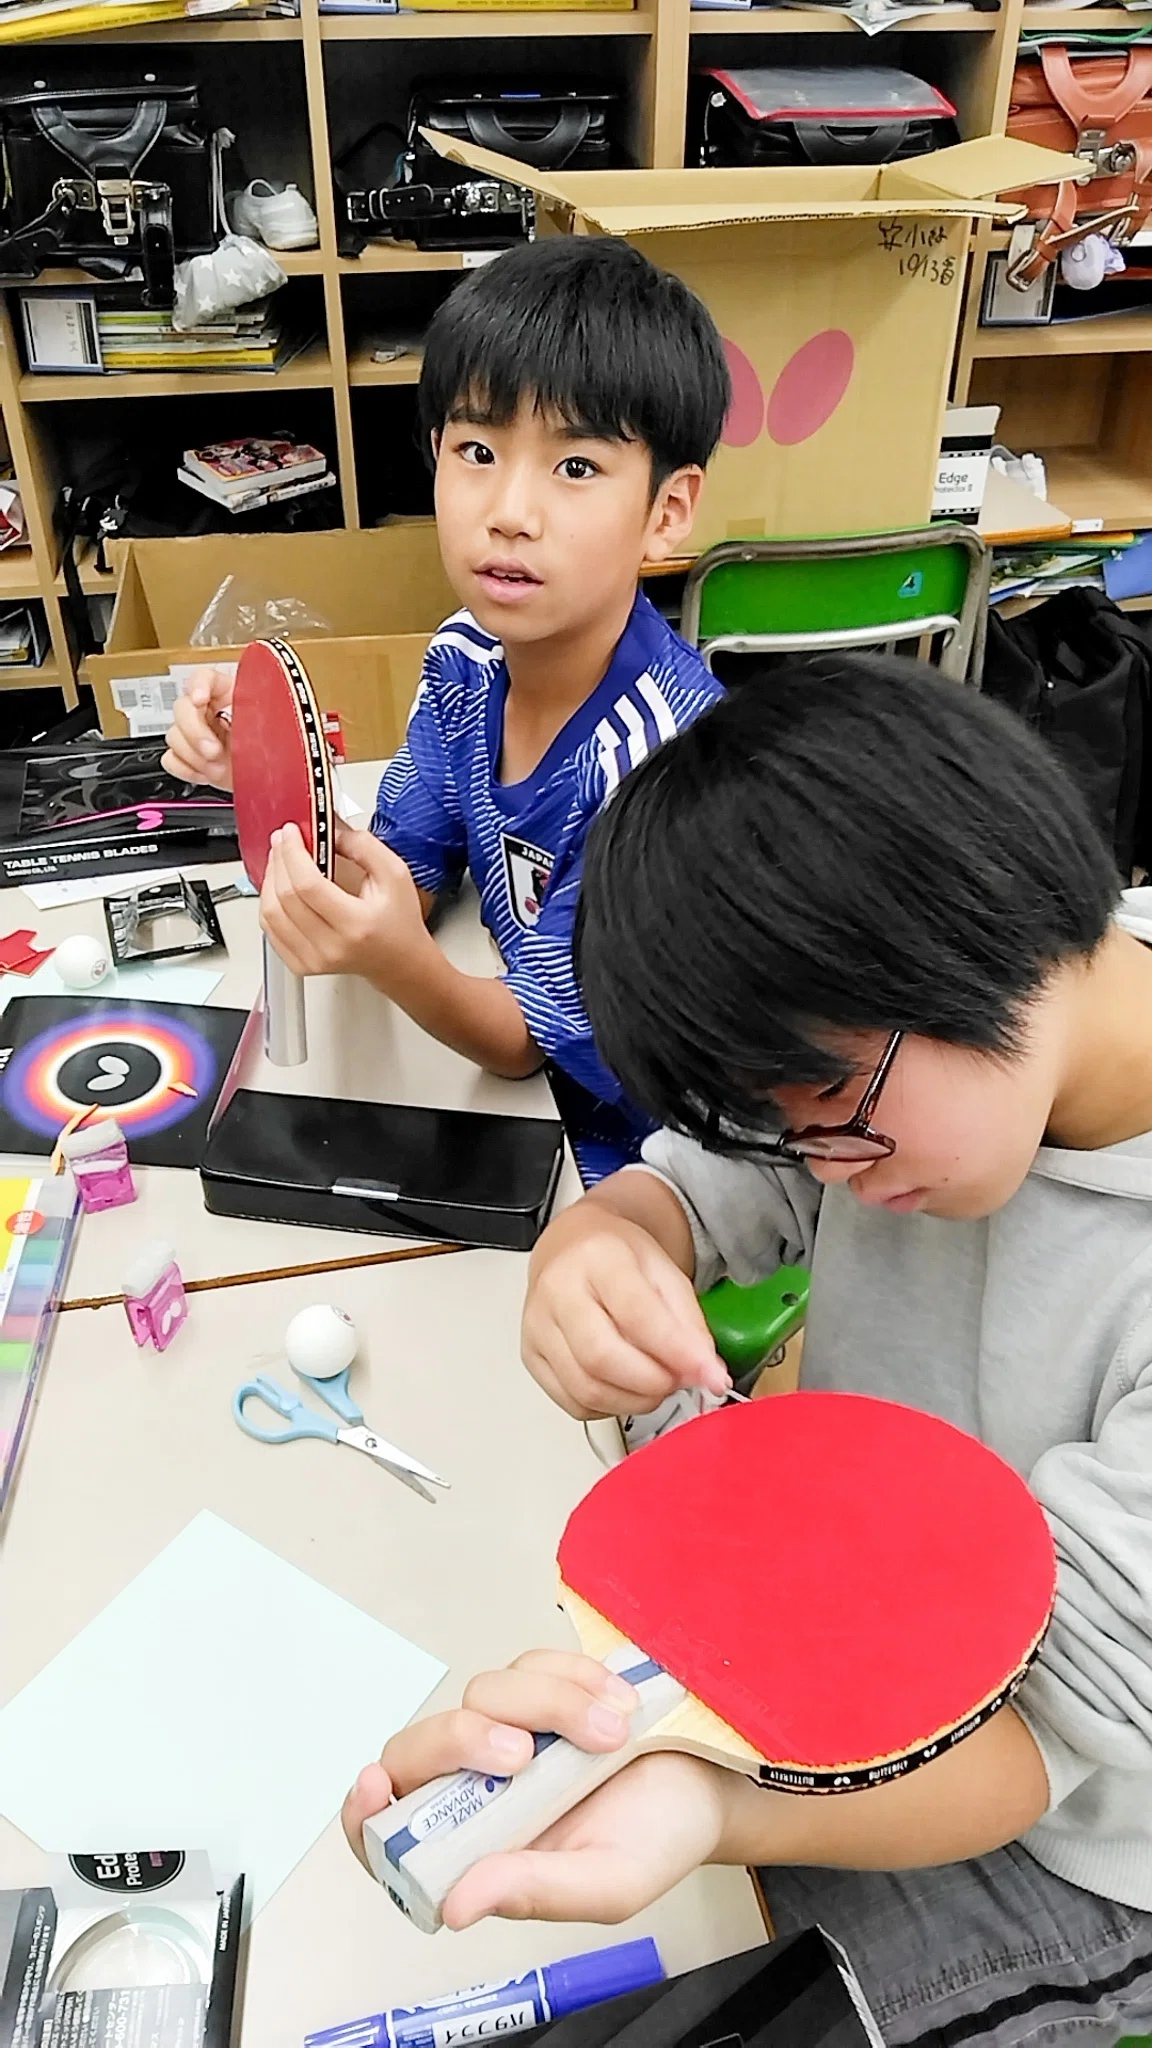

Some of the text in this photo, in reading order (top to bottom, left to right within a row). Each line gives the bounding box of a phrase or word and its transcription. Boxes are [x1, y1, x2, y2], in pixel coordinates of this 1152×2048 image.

[938, 472, 969, 486] Edge
[3, 844, 159, 869] TABLE TENNIS BLADES
[770, 1772, 815, 1786] BUTTERFLY
[424, 1783, 476, 1831] ADVANCE
[94, 1854, 122, 1880] Ed
[125, 1852, 142, 1887] Prote
[446, 2011, 525, 2045] バタフライ
